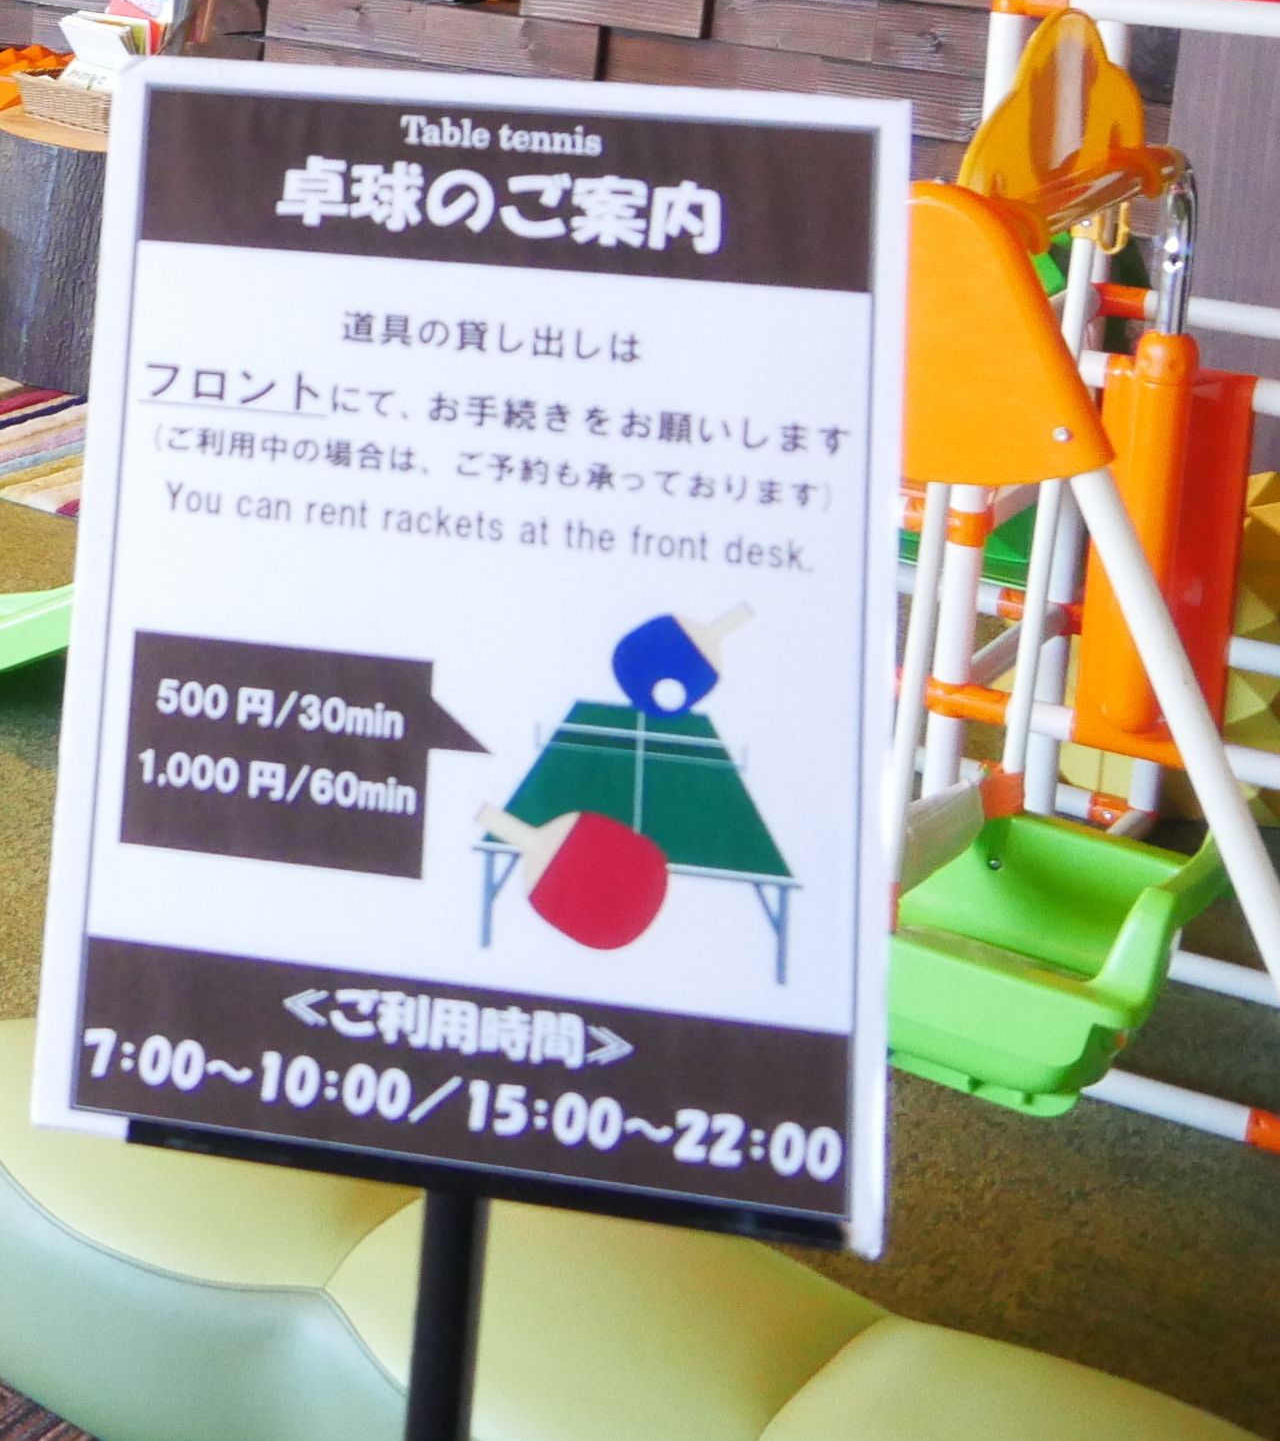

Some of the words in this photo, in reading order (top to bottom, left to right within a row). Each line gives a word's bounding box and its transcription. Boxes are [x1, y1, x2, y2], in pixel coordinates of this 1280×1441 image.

[399, 114, 490, 149] Table
[498, 123, 603, 157] tennis
[275, 155, 722, 254] 卓球のご案内
[343, 311, 640, 363] 道具の貸し出しは
[166, 480, 221, 515] You
[237, 495, 291, 522] can
[306, 501, 367, 529] rent
[383, 506, 503, 543] rackets
[520, 517, 548, 546] at
[566, 520, 615, 552] the
[632, 524, 708, 562] front
[725, 535, 813, 572] desk.
